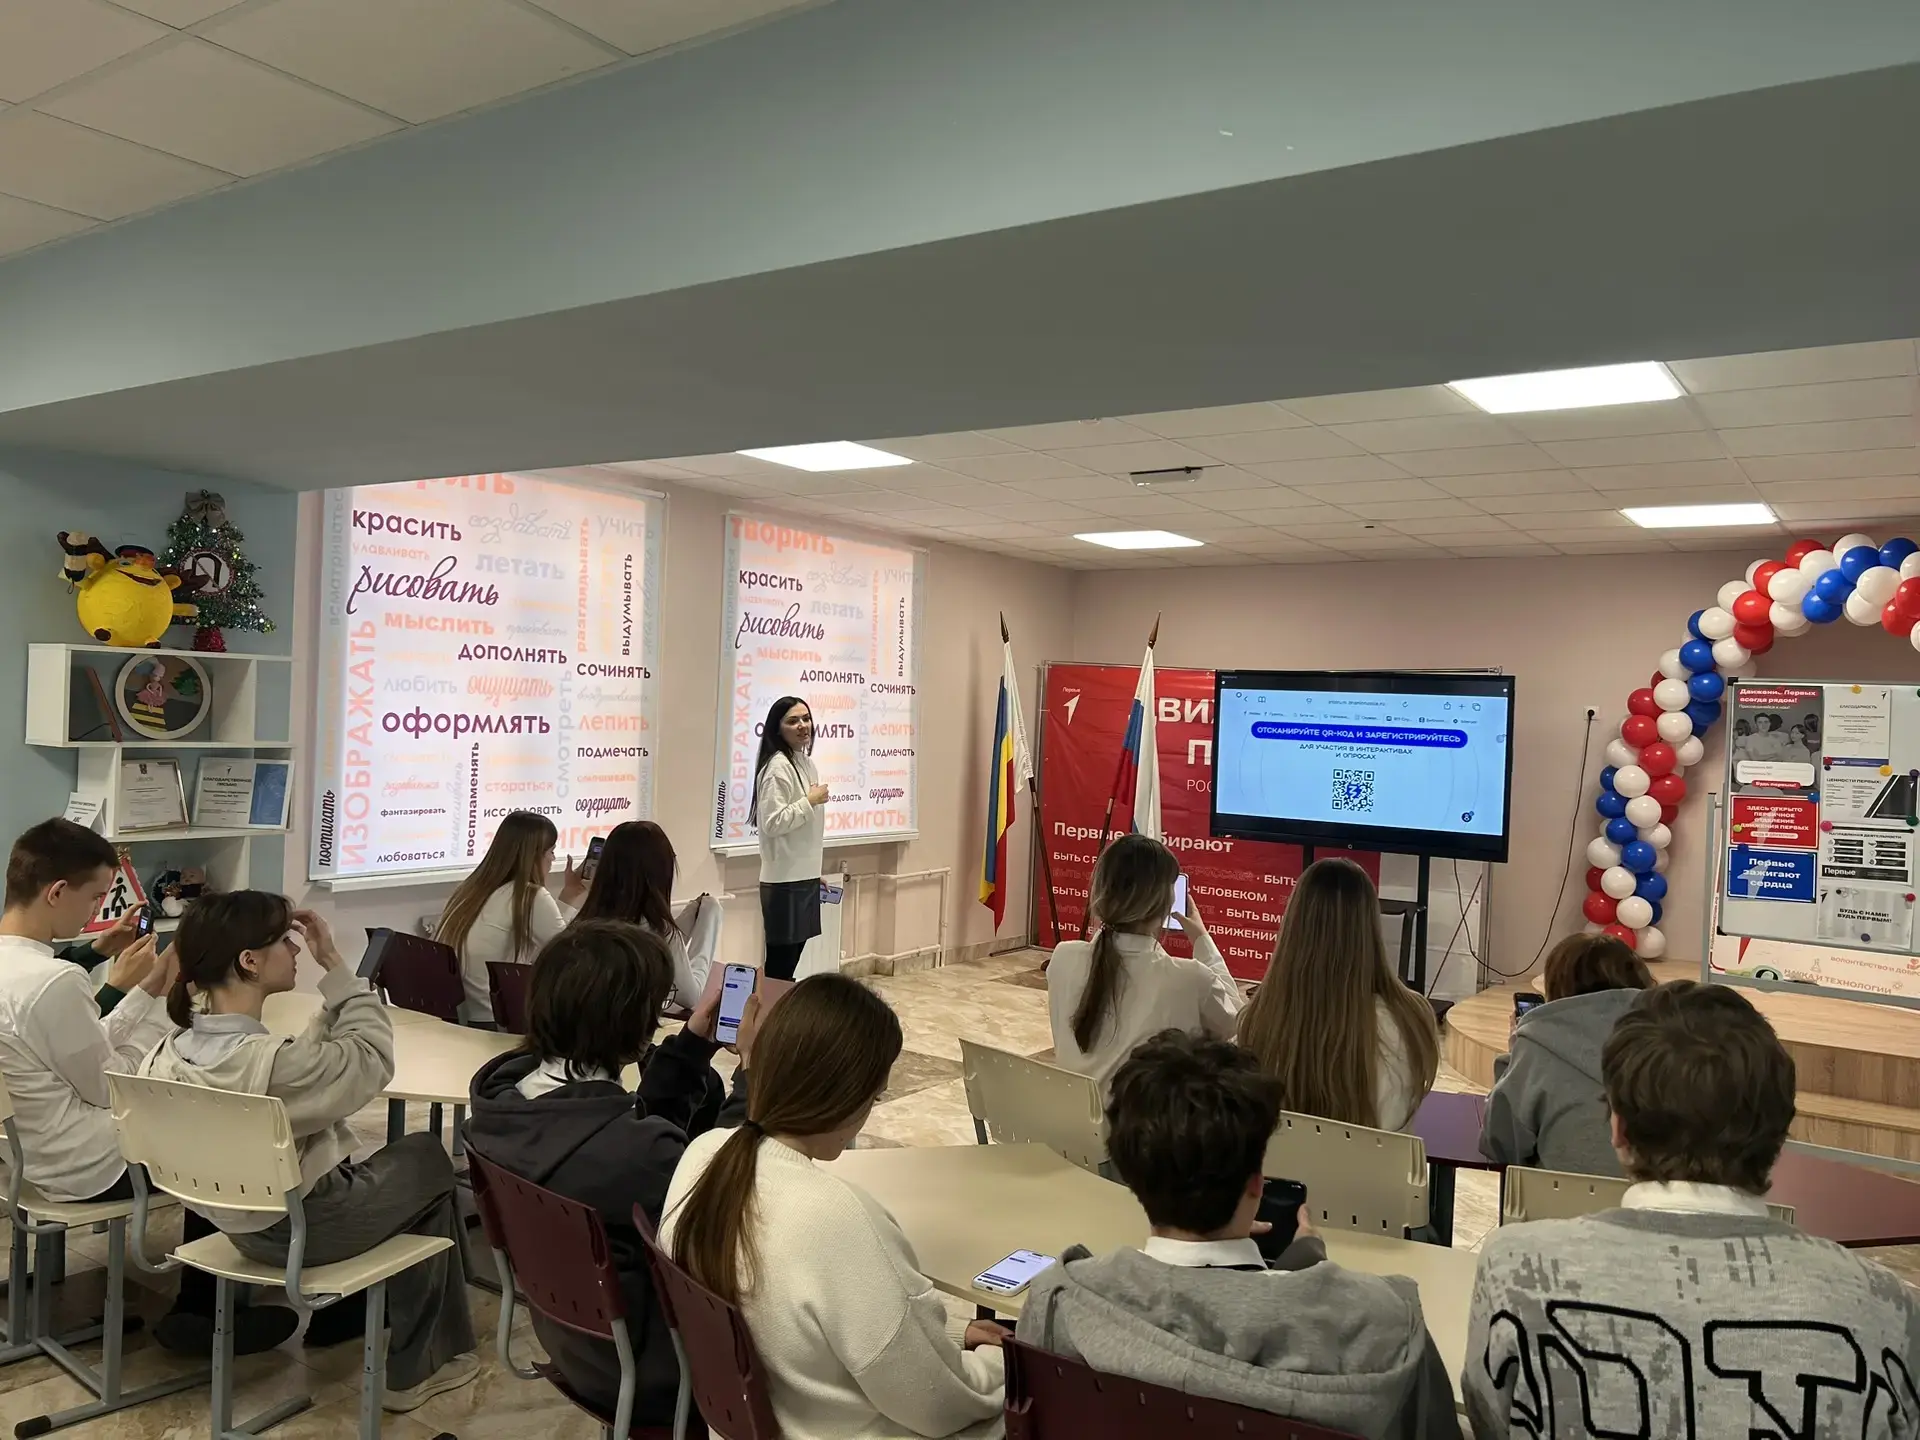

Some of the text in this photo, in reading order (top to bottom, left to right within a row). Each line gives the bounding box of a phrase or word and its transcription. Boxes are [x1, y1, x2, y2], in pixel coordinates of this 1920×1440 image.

[352, 509, 462, 541] красить
[597, 514, 654, 539] учить
[730, 517, 835, 556] творить
[475, 553, 565, 580] летать
[346, 556, 499, 615] рисовать
[739, 570, 803, 592] красить
[622, 553, 633, 656] выдумывать
[811, 600, 864, 620] летать
[384, 612, 495, 636] мыслить
[735, 603, 825, 649] рисовать
[458, 643, 567, 665] дополнять
[757, 646, 822, 663] мыслить
[576, 662, 651, 680] сочинять
[800, 669, 865, 685] дополнять
[383, 674, 458, 695] любить
[871, 682, 916, 696] сочинять
[382, 706, 550, 739] оформлять
[579, 714, 649, 731] лепить
[871, 723, 915, 736] лепить
[556, 669, 575, 799] смотреть
[1257, 726, 1320, 736] ОТСКАНИРУЙТЕ
[1322, 729, 1354, 738] QR-КОД
[1365, 731, 1461, 743] ЗАРЕГИСТРИРУЙТЕСЬ
[340, 619, 376, 867] ИЗОБРАЖАТЬ
[727, 651, 754, 839] ИЗОБРАЖАТЬ
[1356, 746, 1412, 754] ИНТЕРАКТИВАХ
[577, 747, 649, 758] подмечать
[870, 748, 915, 758] подмечать
[466, 741, 480, 857] воспламенять
[575, 797, 631, 818] созерцать
[380, 807, 446, 817] фантазировать
[715, 780, 726, 839] постигать
[319, 788, 336, 867] постигать
[377, 851, 445, 864] любоваться
[1053, 852, 1081, 863] БЫТЬ
[1749, 858, 1795, 868] Первые
[1743, 869, 1801, 879] зажигают
[1824, 867, 1856, 875] Первые
[1264, 874, 1297, 887] БЫТЬ
[1750, 880, 1793, 889] сердца
[1053, 886, 1081, 897] БЫТЬ
[1193, 886, 1267, 902] ЧЕЛОВЕКОМ
[1226, 908, 1260, 921] БЫТЬ
[1857, 914, 1892, 923] ПЕРВЫМ!
[1208, 925, 1278, 942] ДВИЖЕНИИ
[1229, 947, 1262, 960] БЫТЬ
[1825, 976, 1892, 994] ТЕХНОЛОГИИ
